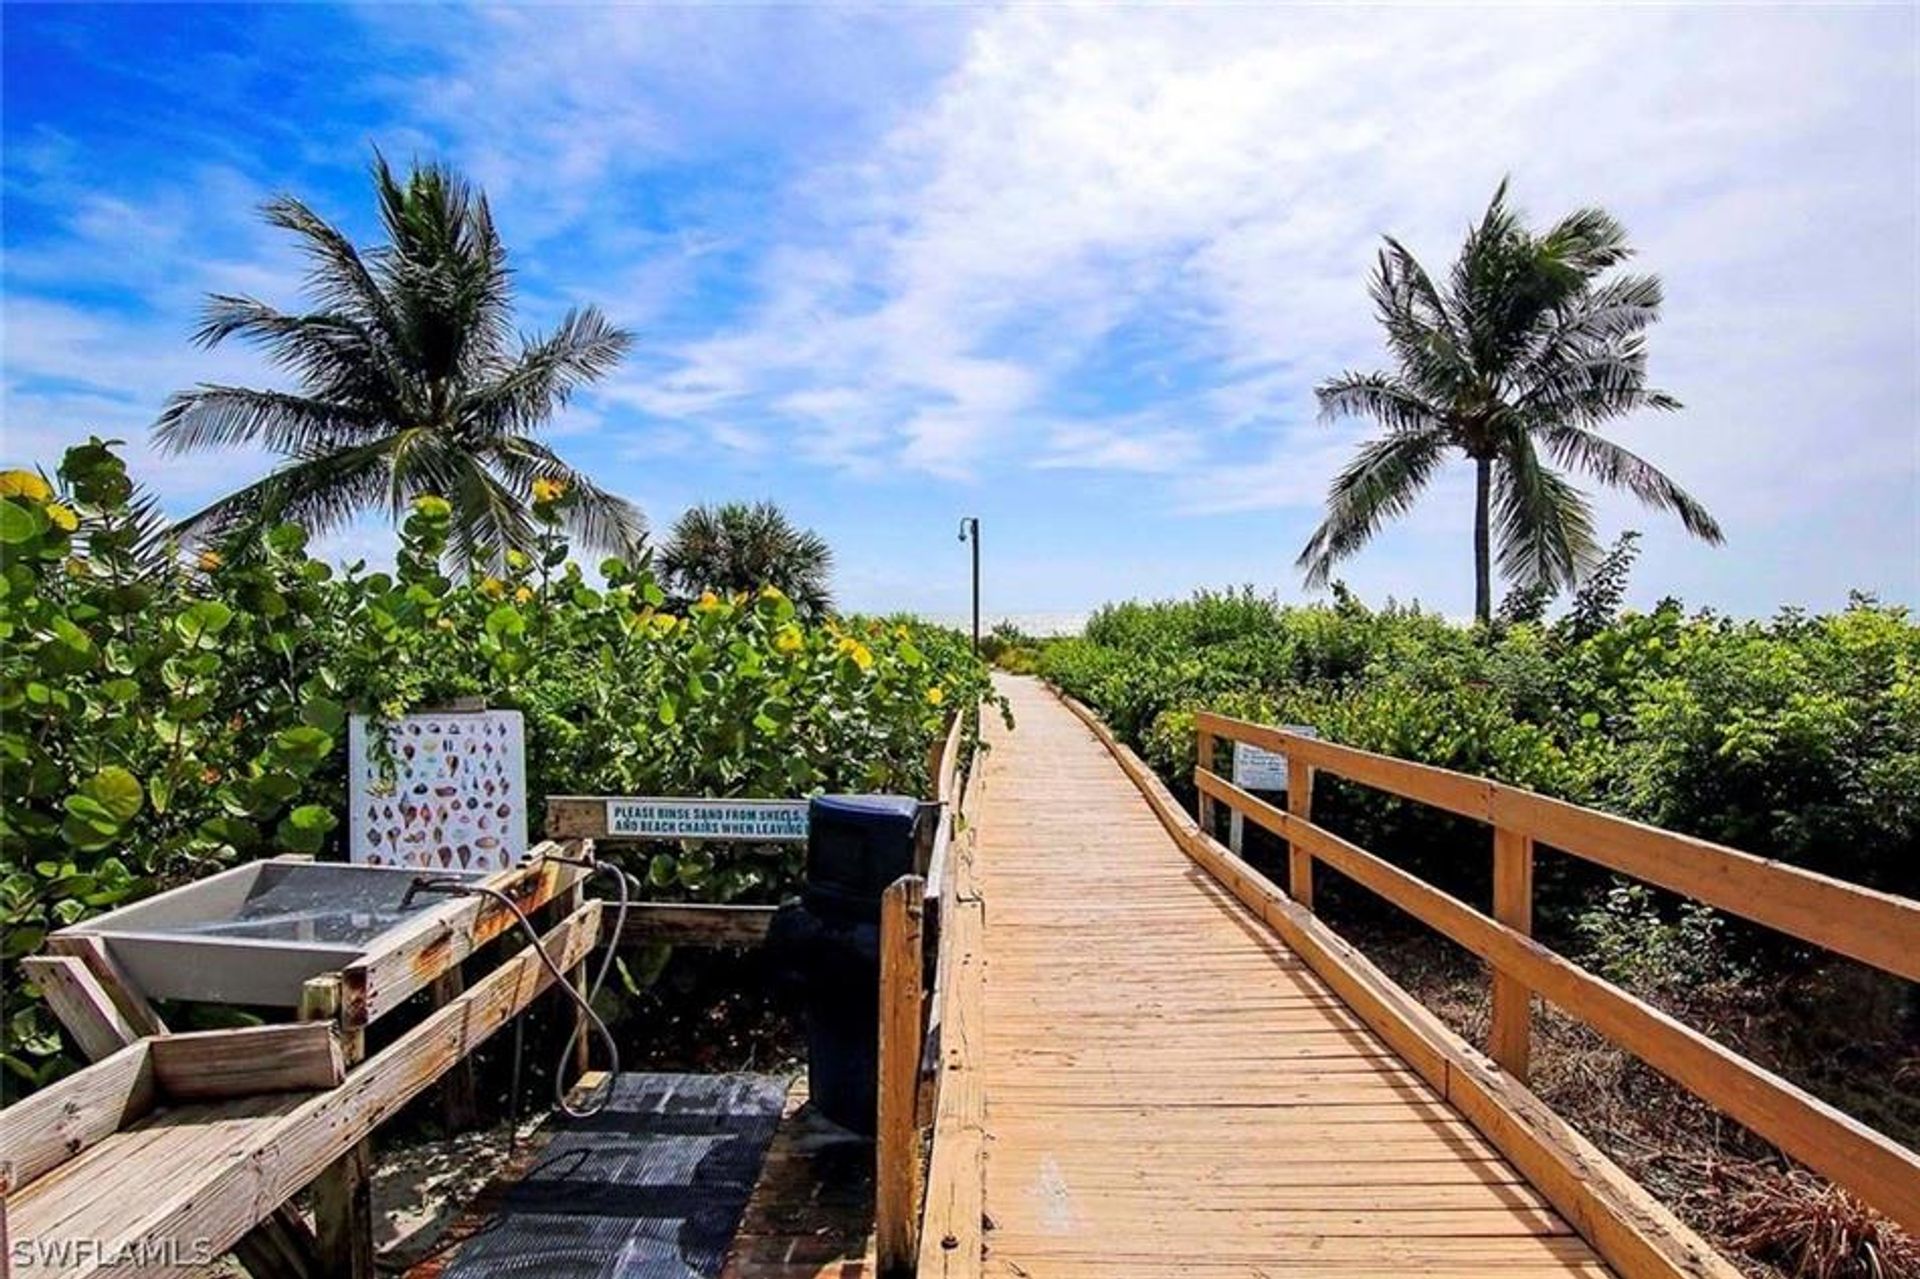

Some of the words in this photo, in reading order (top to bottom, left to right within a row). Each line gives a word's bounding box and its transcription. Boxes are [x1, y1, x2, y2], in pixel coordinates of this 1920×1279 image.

[614, 806, 654, 819] PLEASE
[657, 807, 691, 820] RINSE
[693, 808, 723, 820] SAND
[725, 809, 756, 821] FROM
[615, 820, 638, 832] AND
[640, 821, 676, 833] BEACH
[678, 822, 718, 834] CHAIRS
[721, 823, 754, 834] WHEN
[756, 823, 803, 835] LEAVING
